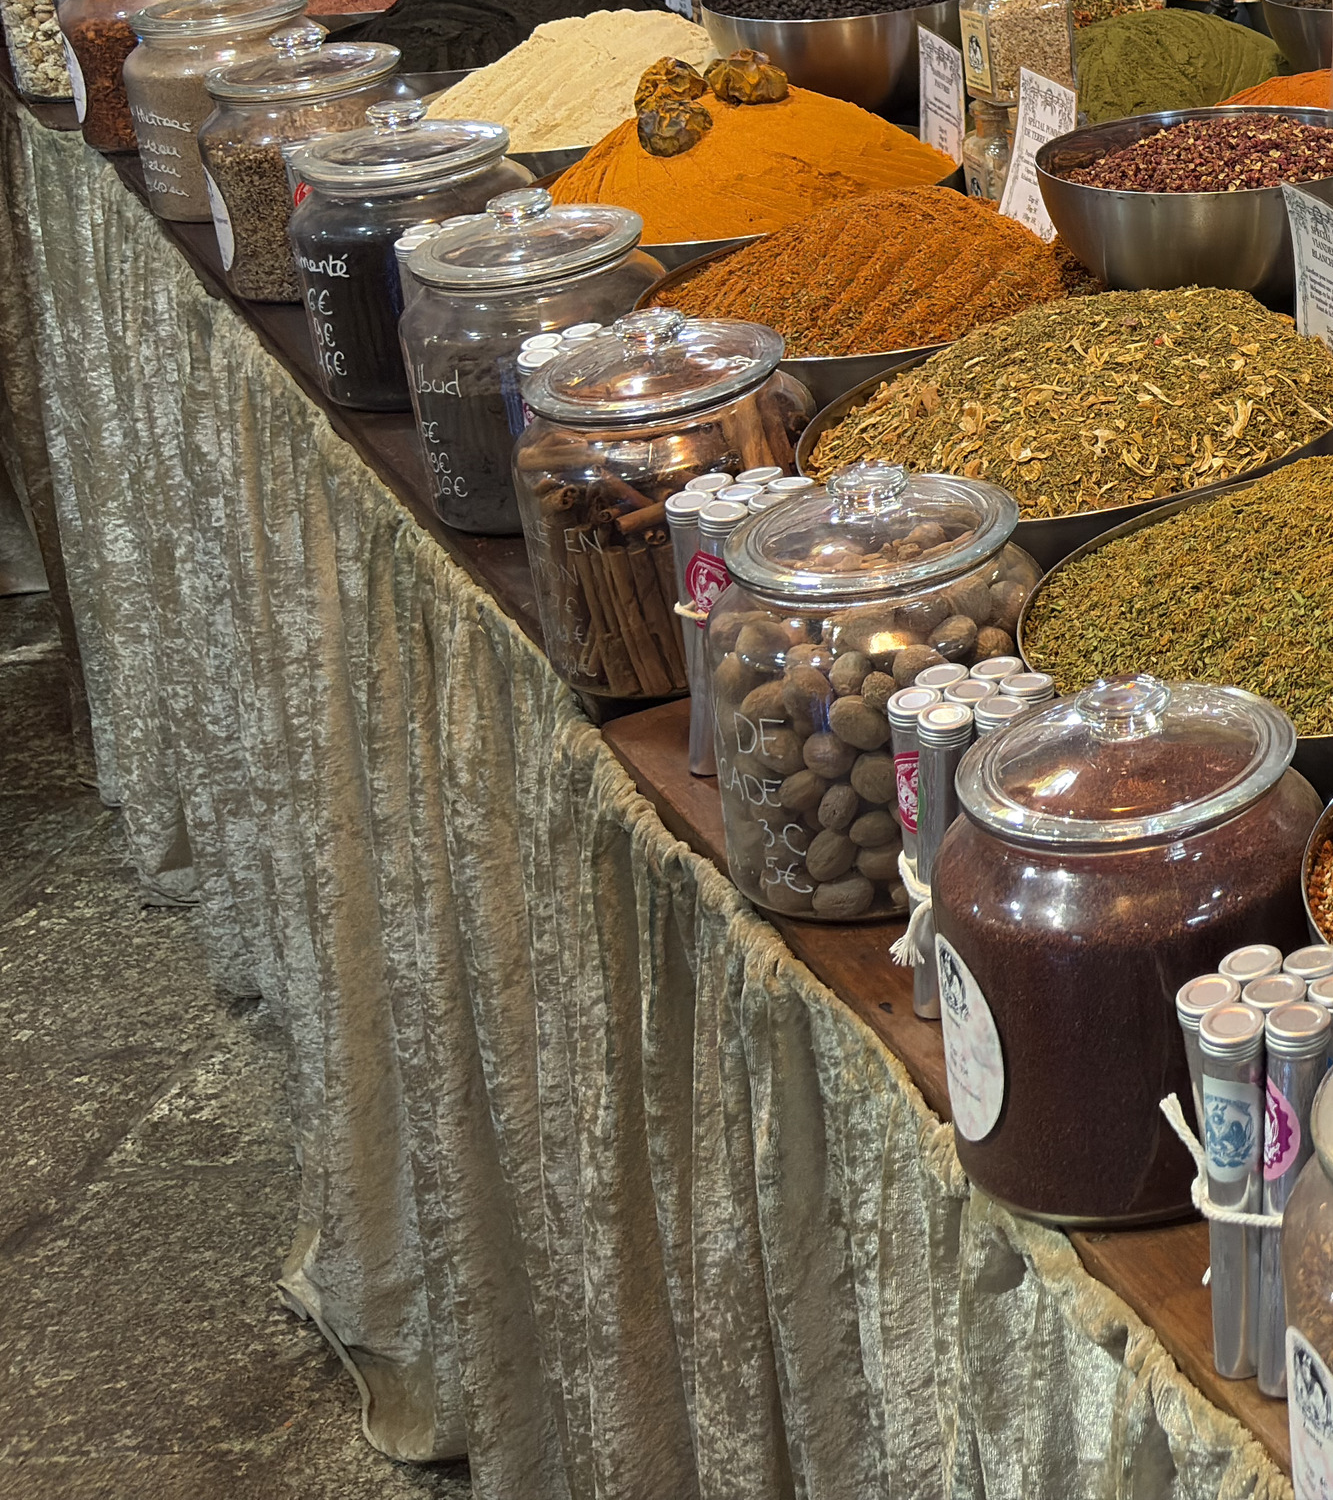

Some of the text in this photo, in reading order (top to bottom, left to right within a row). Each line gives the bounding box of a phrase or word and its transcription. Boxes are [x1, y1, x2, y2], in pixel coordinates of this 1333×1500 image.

[299, 253, 350, 278] menté
[733, 712, 785, 755] DE
[719, 757, 783, 807] CADE
